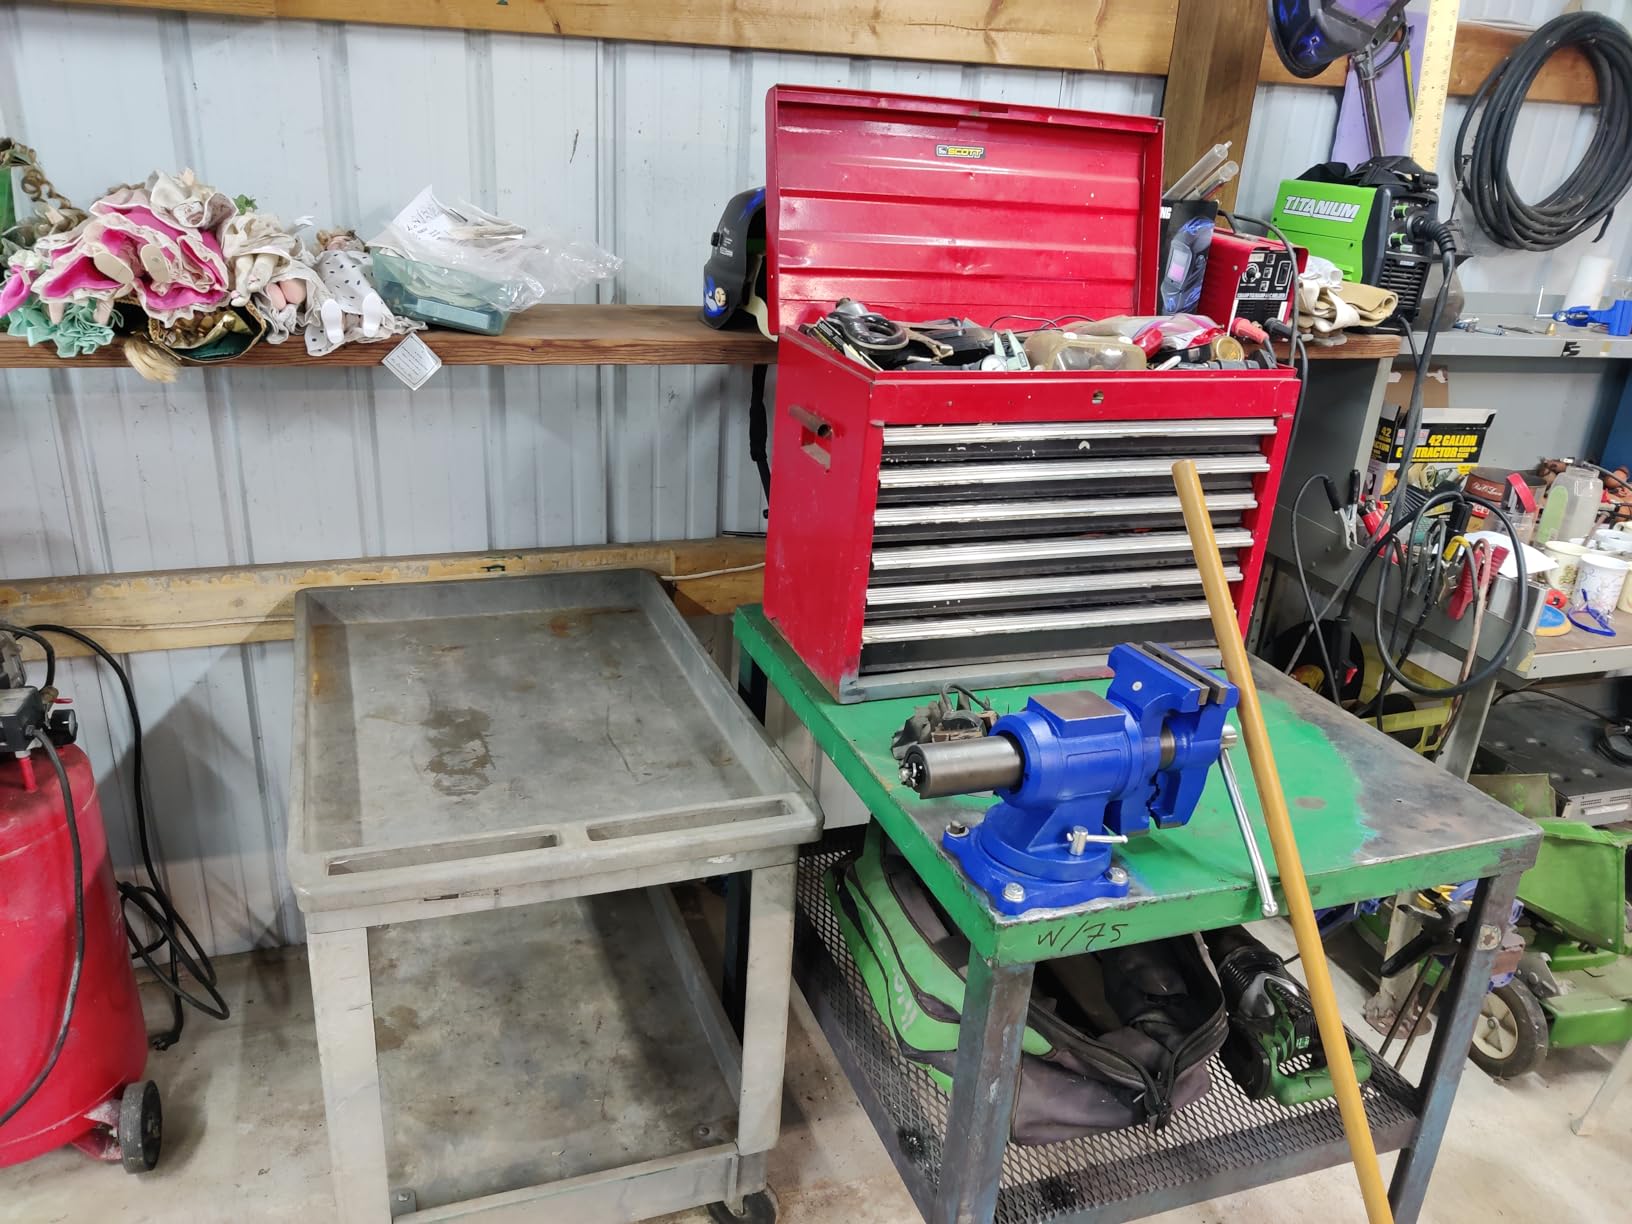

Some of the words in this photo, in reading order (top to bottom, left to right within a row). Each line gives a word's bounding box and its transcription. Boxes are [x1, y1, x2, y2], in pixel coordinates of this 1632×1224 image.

[948, 147, 982, 157] SCOTT
[1283, 195, 1361, 220] TITANIUM
[1428, 434, 1443, 446] 42
[1442, 435, 1477, 446] GALLON
